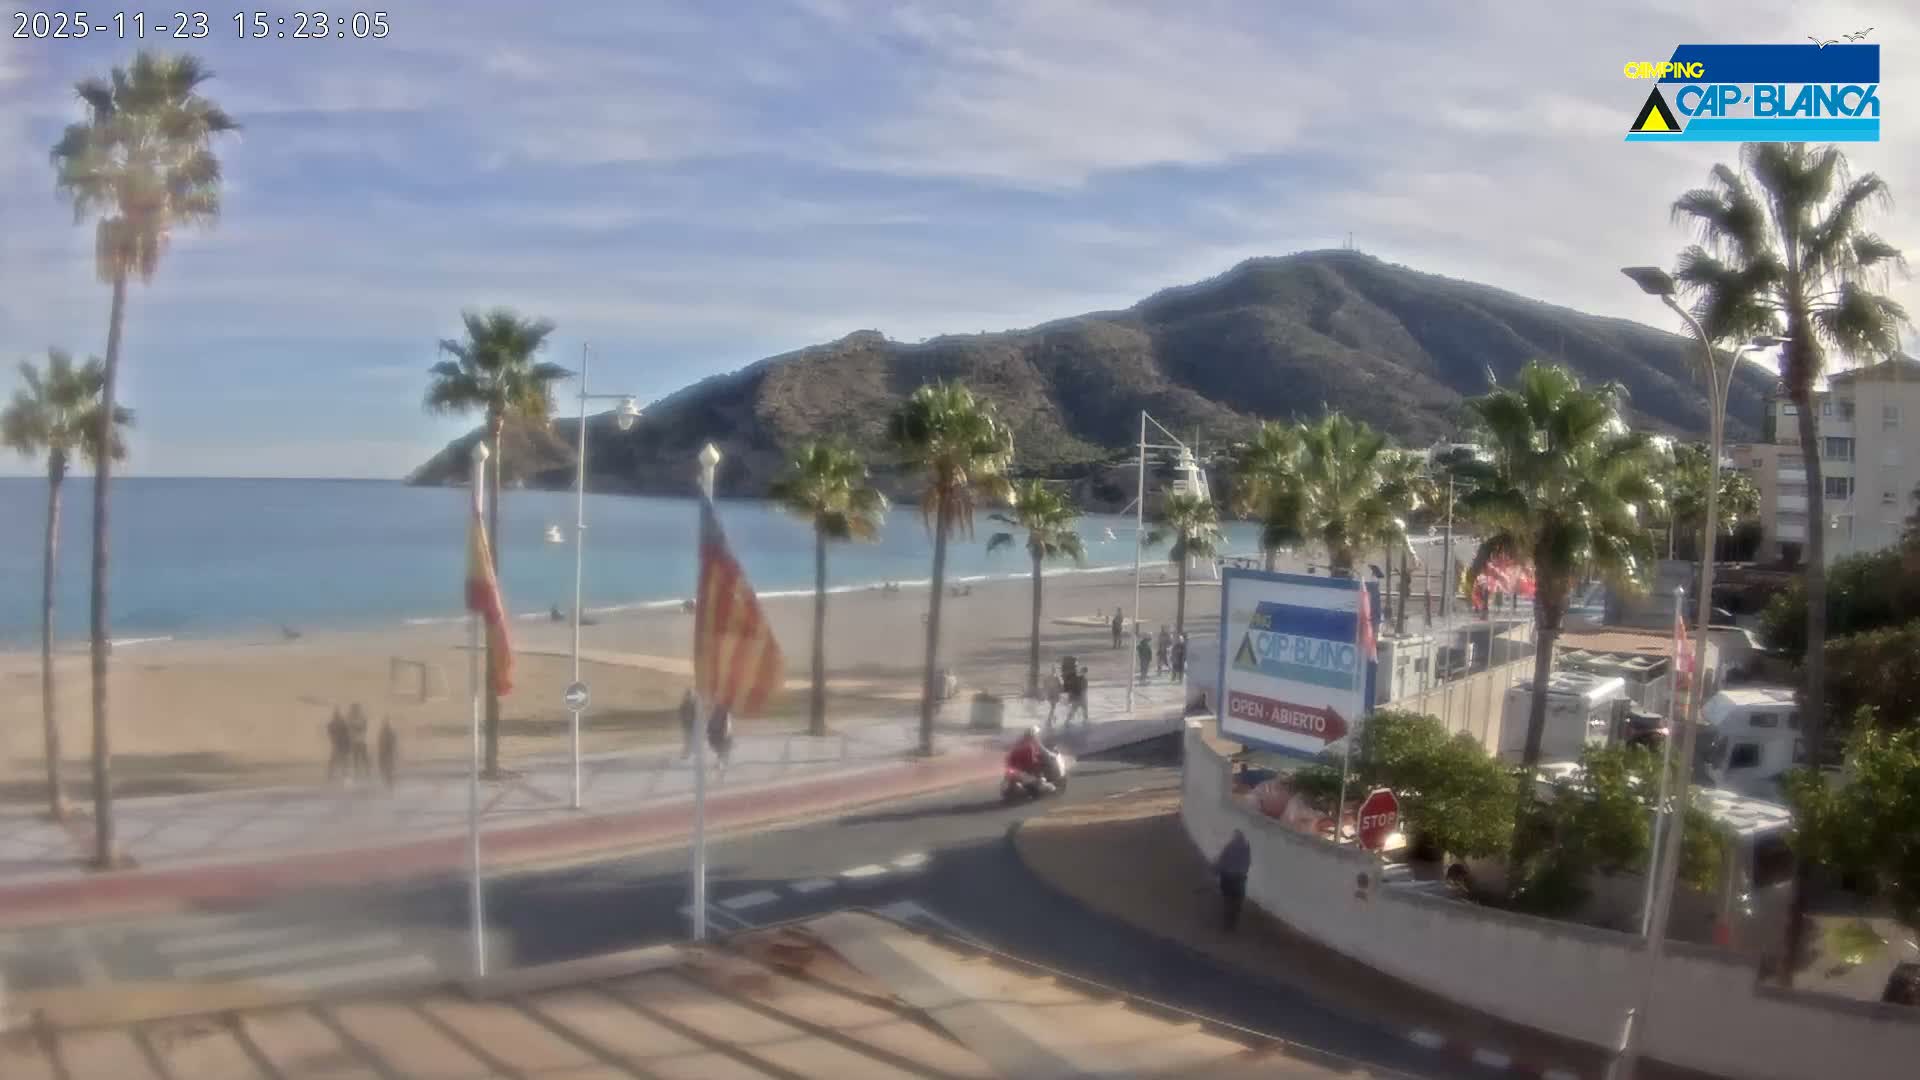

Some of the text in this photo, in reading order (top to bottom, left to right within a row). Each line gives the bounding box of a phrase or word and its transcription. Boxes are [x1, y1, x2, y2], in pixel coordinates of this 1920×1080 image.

[1231, 698, 1264, 719] OPEN
[1271, 707, 1327, 732] ABIERTO
[1362, 812, 1396, 830] STOP
